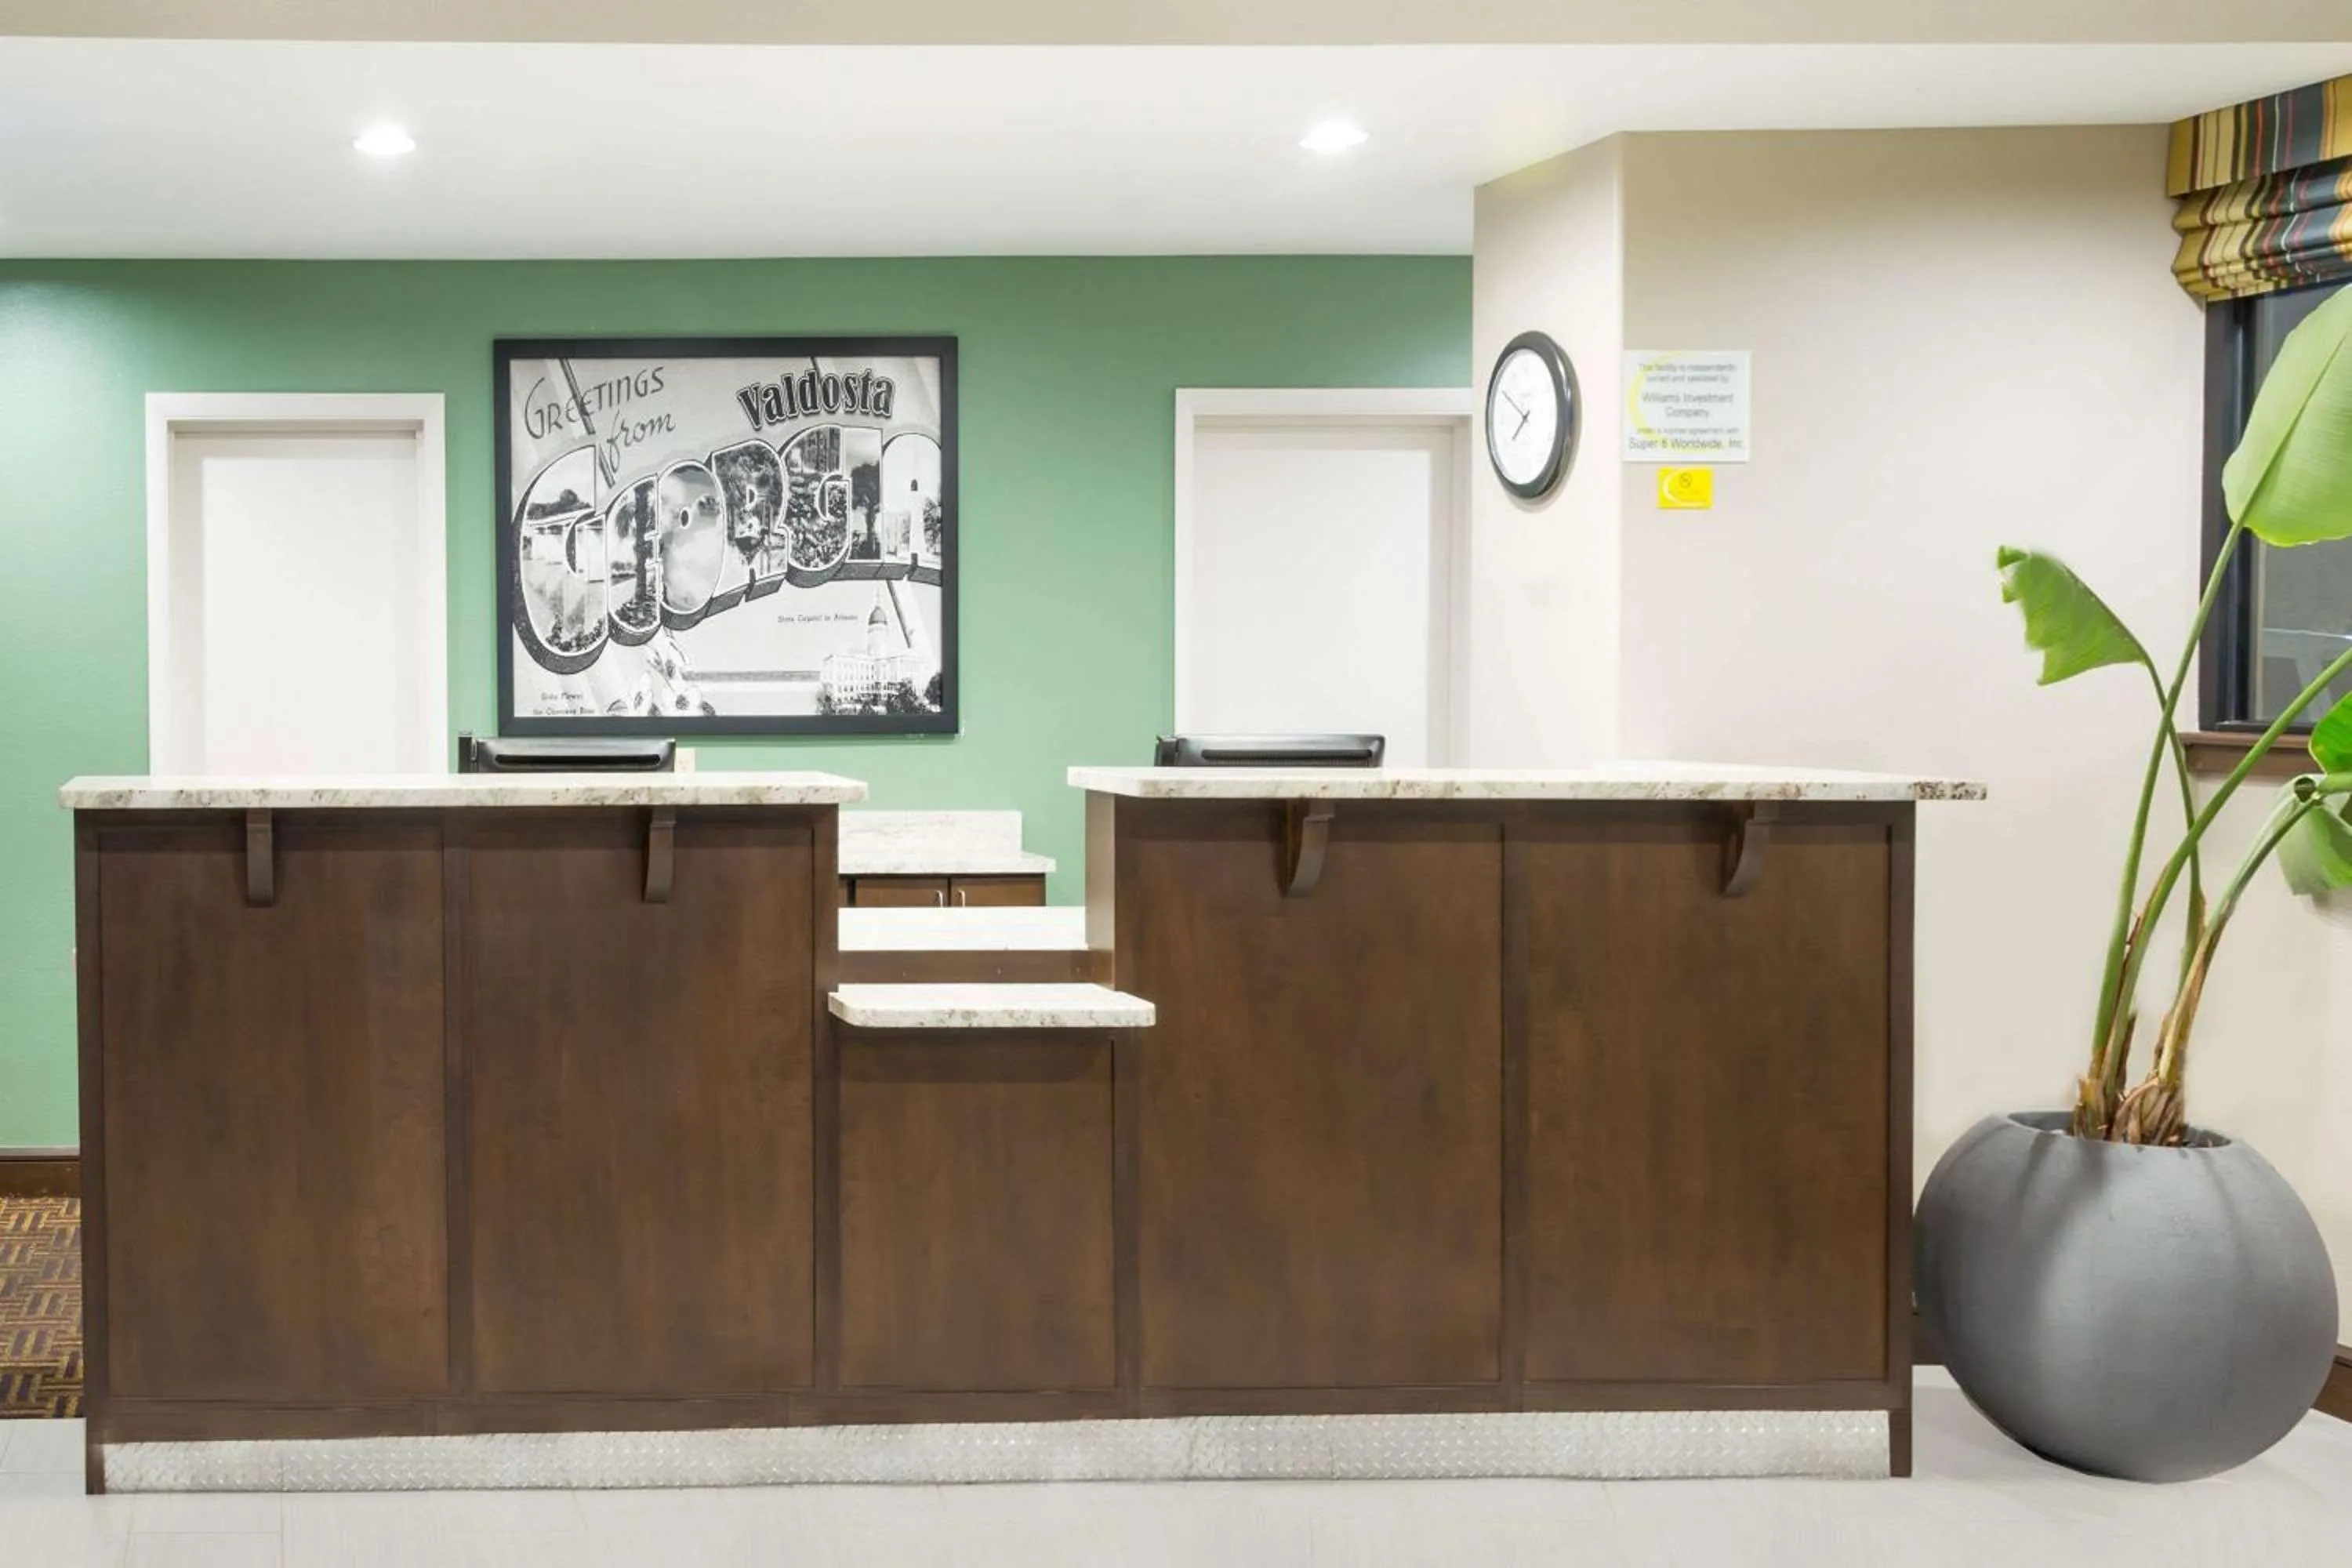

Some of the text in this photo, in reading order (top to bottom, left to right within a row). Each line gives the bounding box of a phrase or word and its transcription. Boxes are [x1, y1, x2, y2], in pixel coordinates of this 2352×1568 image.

[737, 368, 895, 430] Valdosta
[1665, 407, 1710, 419] Company
[1683, 393, 1734, 403] Investment
[607, 409, 677, 474] from
[1628, 437, 1658, 450] Super
[511, 423, 942, 674] GEORGIA
